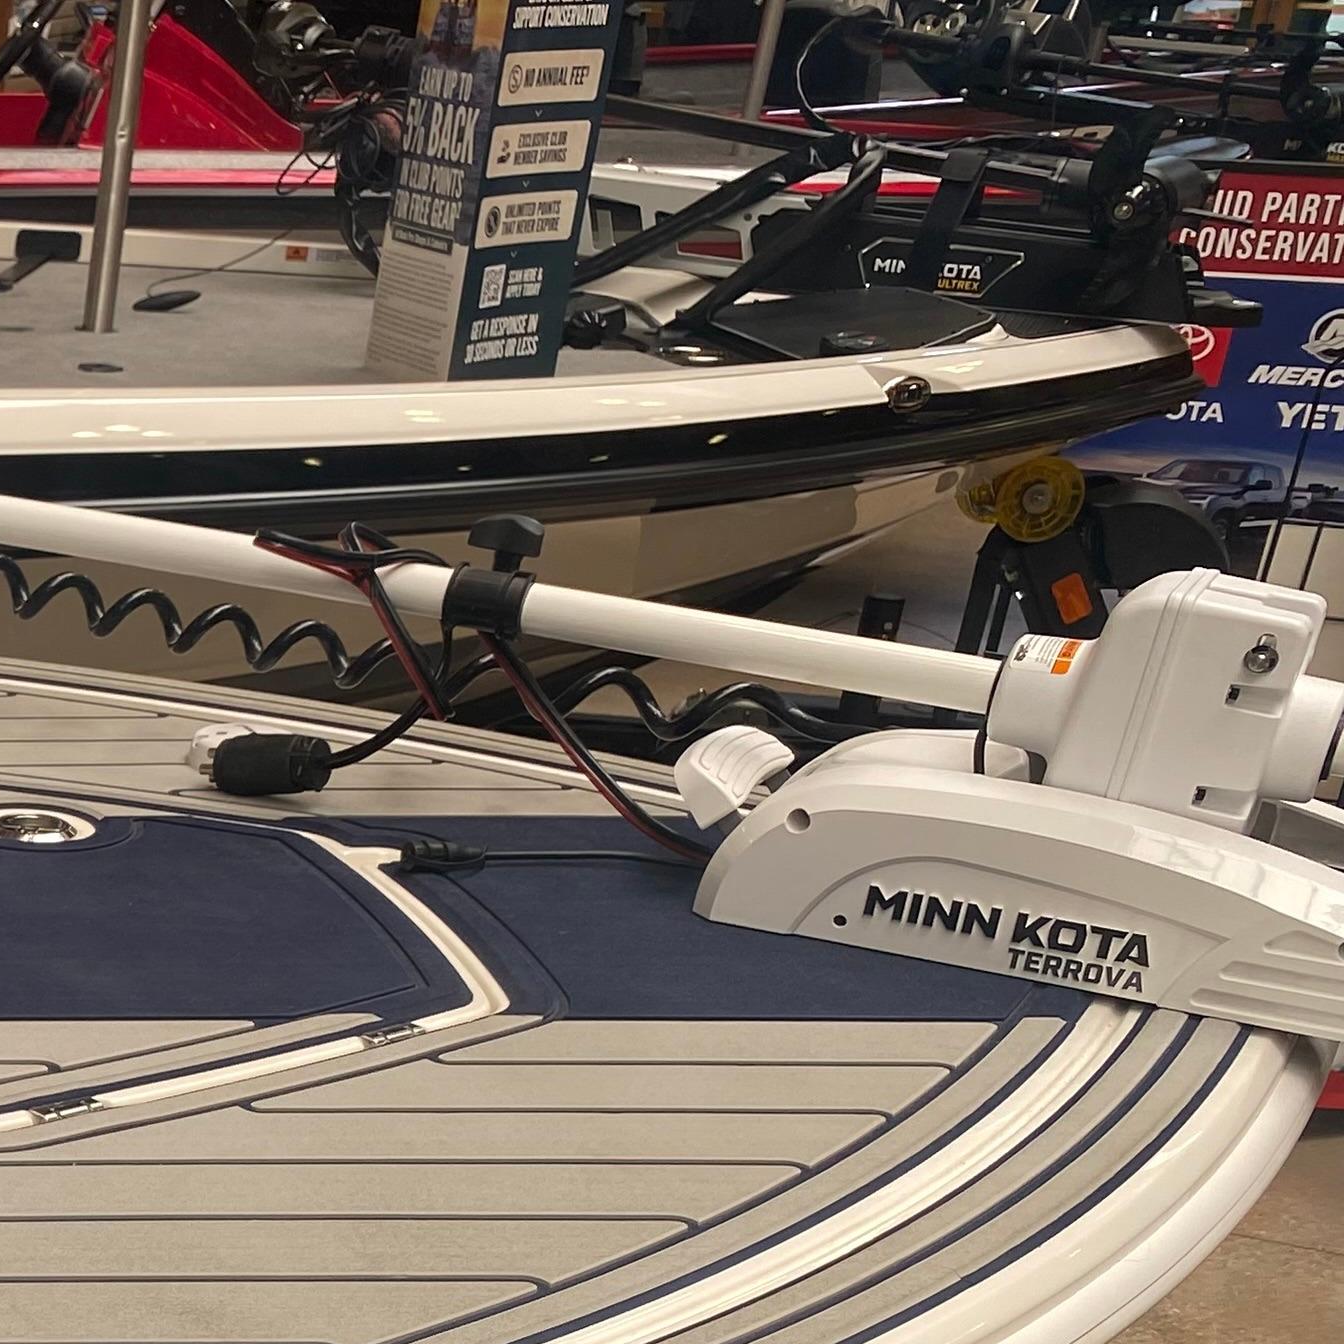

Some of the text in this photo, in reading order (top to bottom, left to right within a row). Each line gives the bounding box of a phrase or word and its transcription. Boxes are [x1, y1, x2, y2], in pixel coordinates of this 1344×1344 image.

[544, 4, 609, 28] CONSERVATION
[459, 71, 473, 102] TO
[523, 68, 535, 88] NO
[535, 66, 568, 87] ANNUAL
[403, 96, 480, 165] 5% BACK
[550, 131, 568, 147] CLUB
[430, 164, 464, 199] POINTS
[1261, 191, 1344, 226] PART
[939, 263, 981, 279] OTA
[937, 279, 980, 292] ULTREX
[489, 314, 528, 337] RESPONSE
[527, 313, 539, 334] IN
[516, 335, 539, 357] LESS
[862, 884, 1150, 968] MINN KOTA
[1007, 948, 1143, 993] TERROVA
